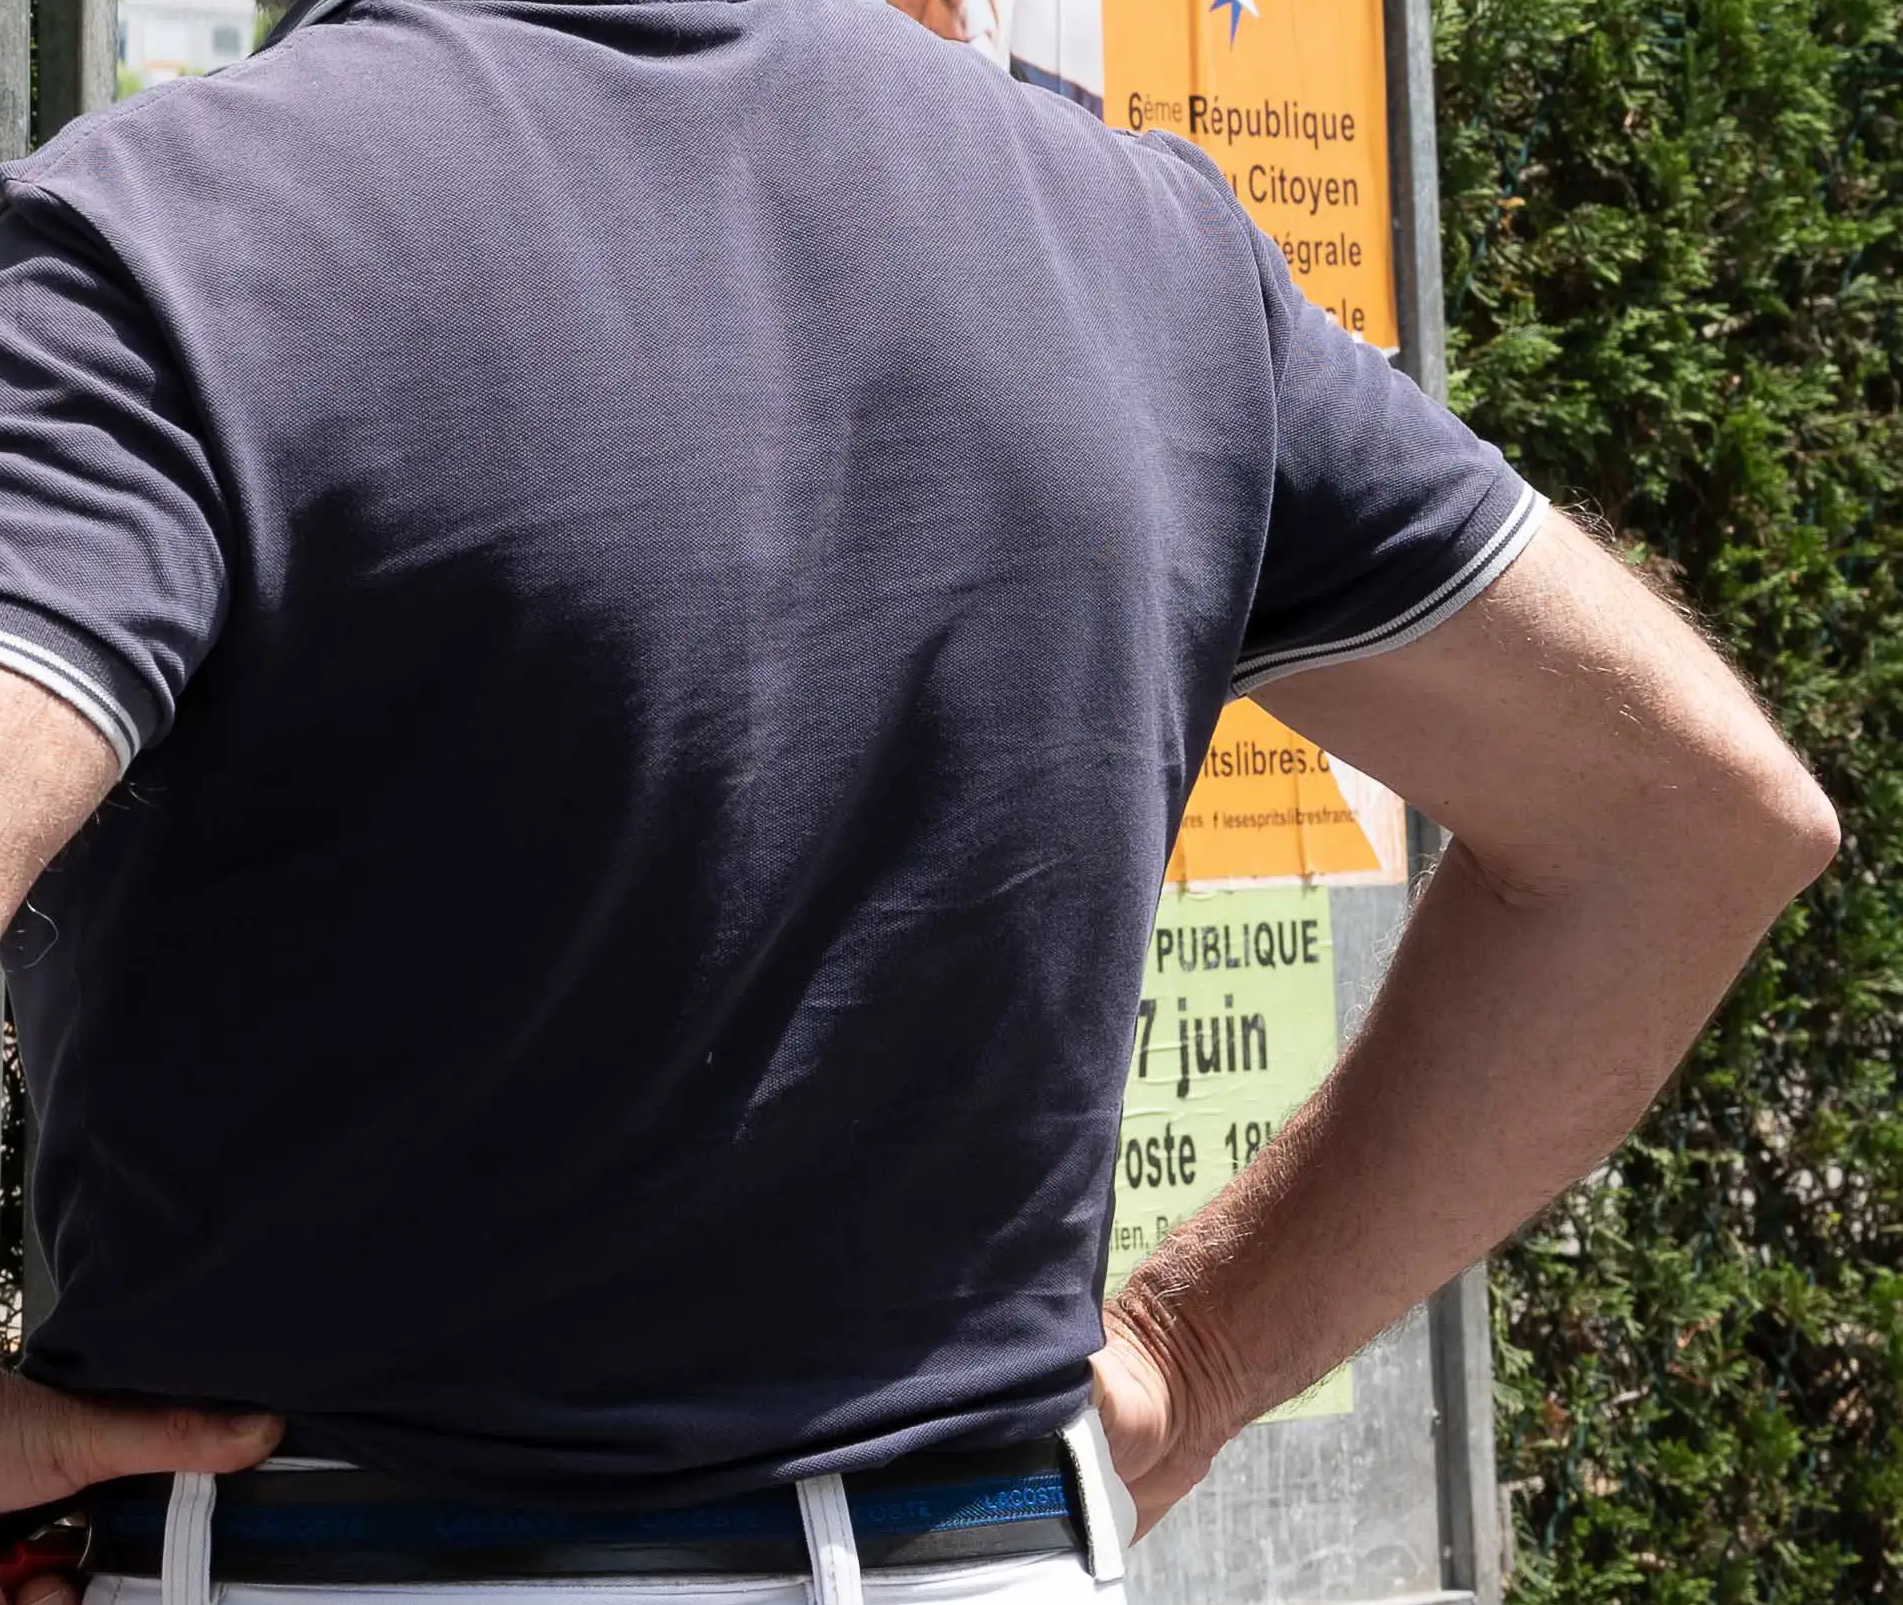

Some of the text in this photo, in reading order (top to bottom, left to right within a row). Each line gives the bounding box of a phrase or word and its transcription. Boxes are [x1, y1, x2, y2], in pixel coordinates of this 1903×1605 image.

[1128, 91, 1354, 152] 6ème République
[1249, 165, 1358, 215] Citoyen
[1274, 233, 1361, 274] égrale
[1157, 920, 1318, 972] PUBLIQUE
[1177, 994, 1267, 1099] juin
